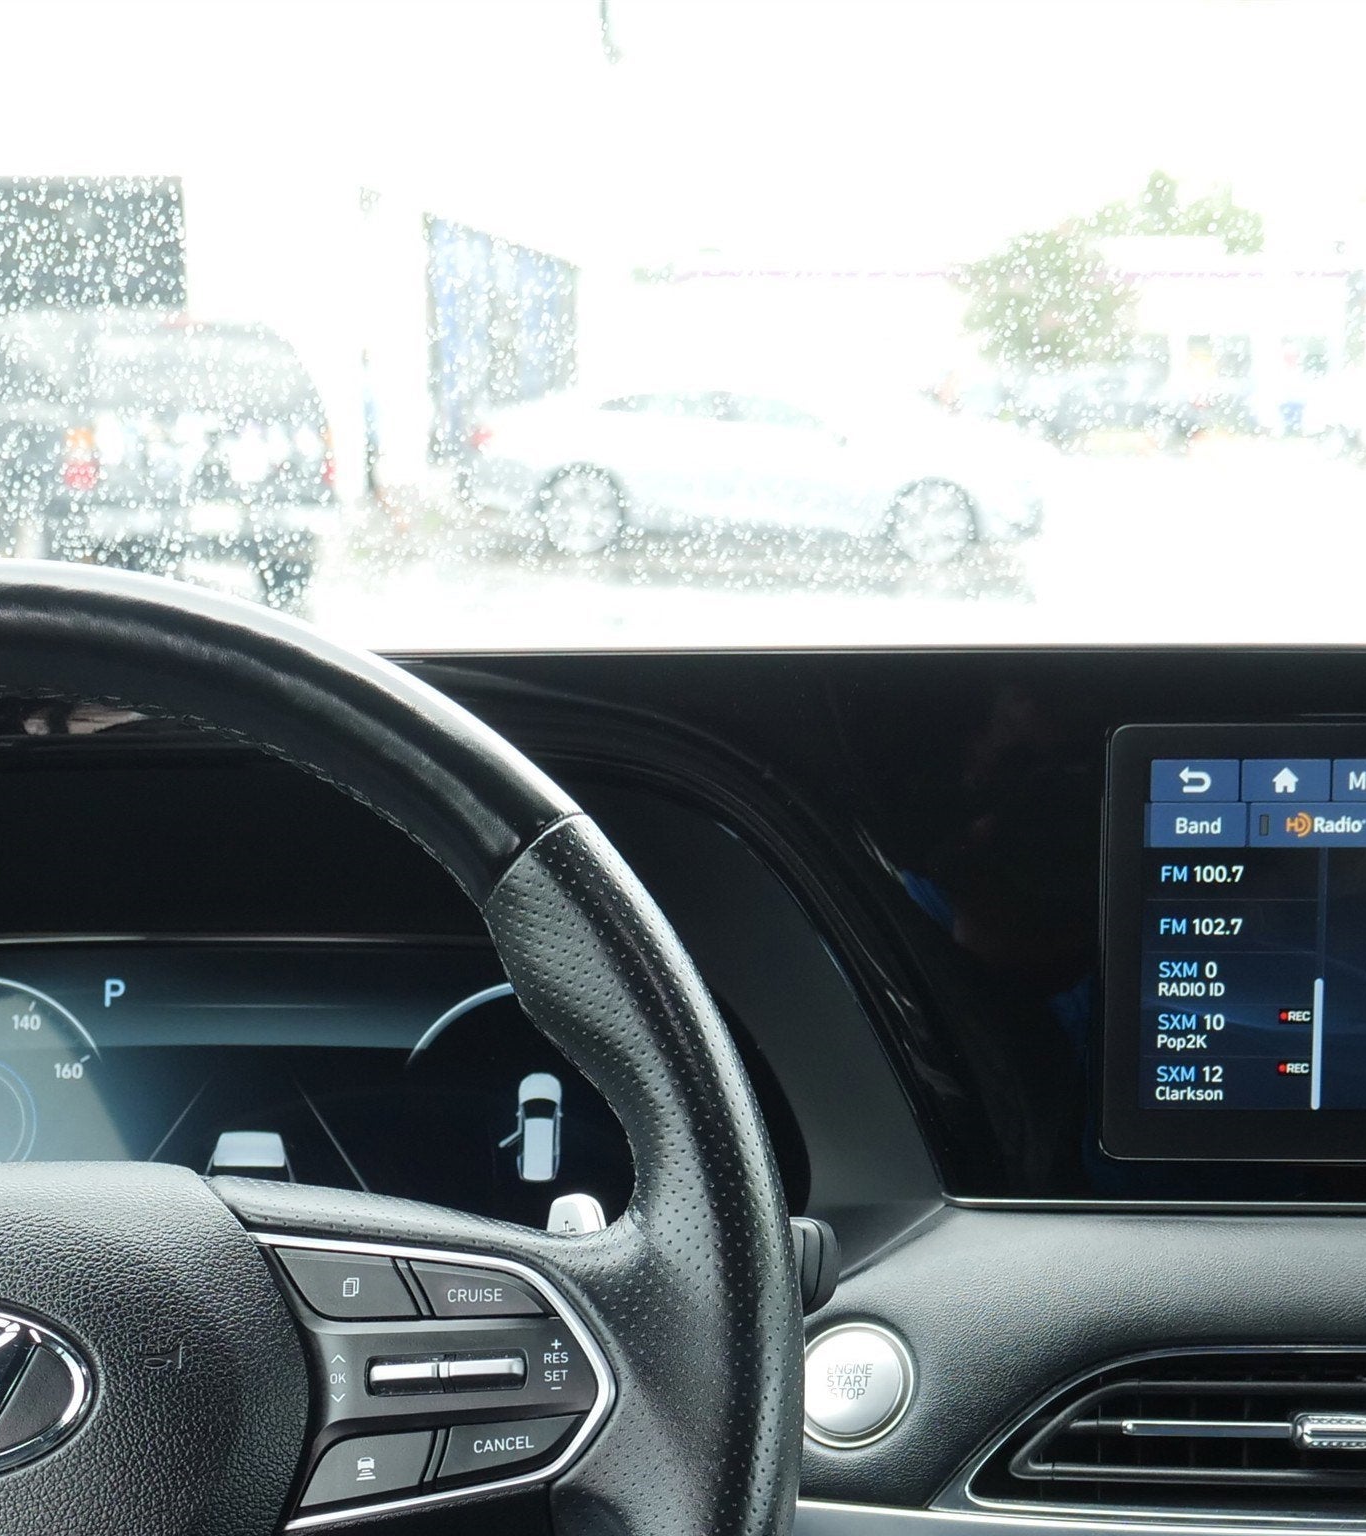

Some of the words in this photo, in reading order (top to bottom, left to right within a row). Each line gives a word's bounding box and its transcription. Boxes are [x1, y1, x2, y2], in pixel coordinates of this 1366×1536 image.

[1176, 817, 1221, 834] Band
[1161, 866, 1188, 883] FM
[1193, 865, 1244, 882] 100.7
[1160, 919, 1186, 935] FM
[1192, 918, 1243, 935] 102.7
[1158, 962, 1198, 978] SXM
[1204, 961, 1218, 978] 0
[104, 979, 126, 1007] P
[1158, 982, 1205, 996] RADIO
[1209, 982, 1225, 996] ID
[11, 1014, 41, 1031] 140
[1157, 1013, 1196, 1030] SXM
[1203, 1013, 1225, 1031] 10
[1288, 1011, 1311, 1021] REC
[1157, 1034, 1207, 1051] Pop2K
[54, 1062, 83, 1079] 160
[1156, 1065, 1196, 1082] SXM
[1202, 1065, 1223, 1082] 12
[1286, 1063, 1309, 1073] REC
[1155, 1086, 1223, 1101] Clarkson
[447, 1288, 503, 1303] CRUISE
[543, 1352, 569, 1364] RES
[543, 1369, 569, 1382] SET
[826, 1363, 874, 1375] ENGINE
[329, 1372, 347, 1384] OK
[826, 1375, 872, 1388] START
[829, 1387, 866, 1400] STOP
[473, 1435, 534, 1454] CANCEL
